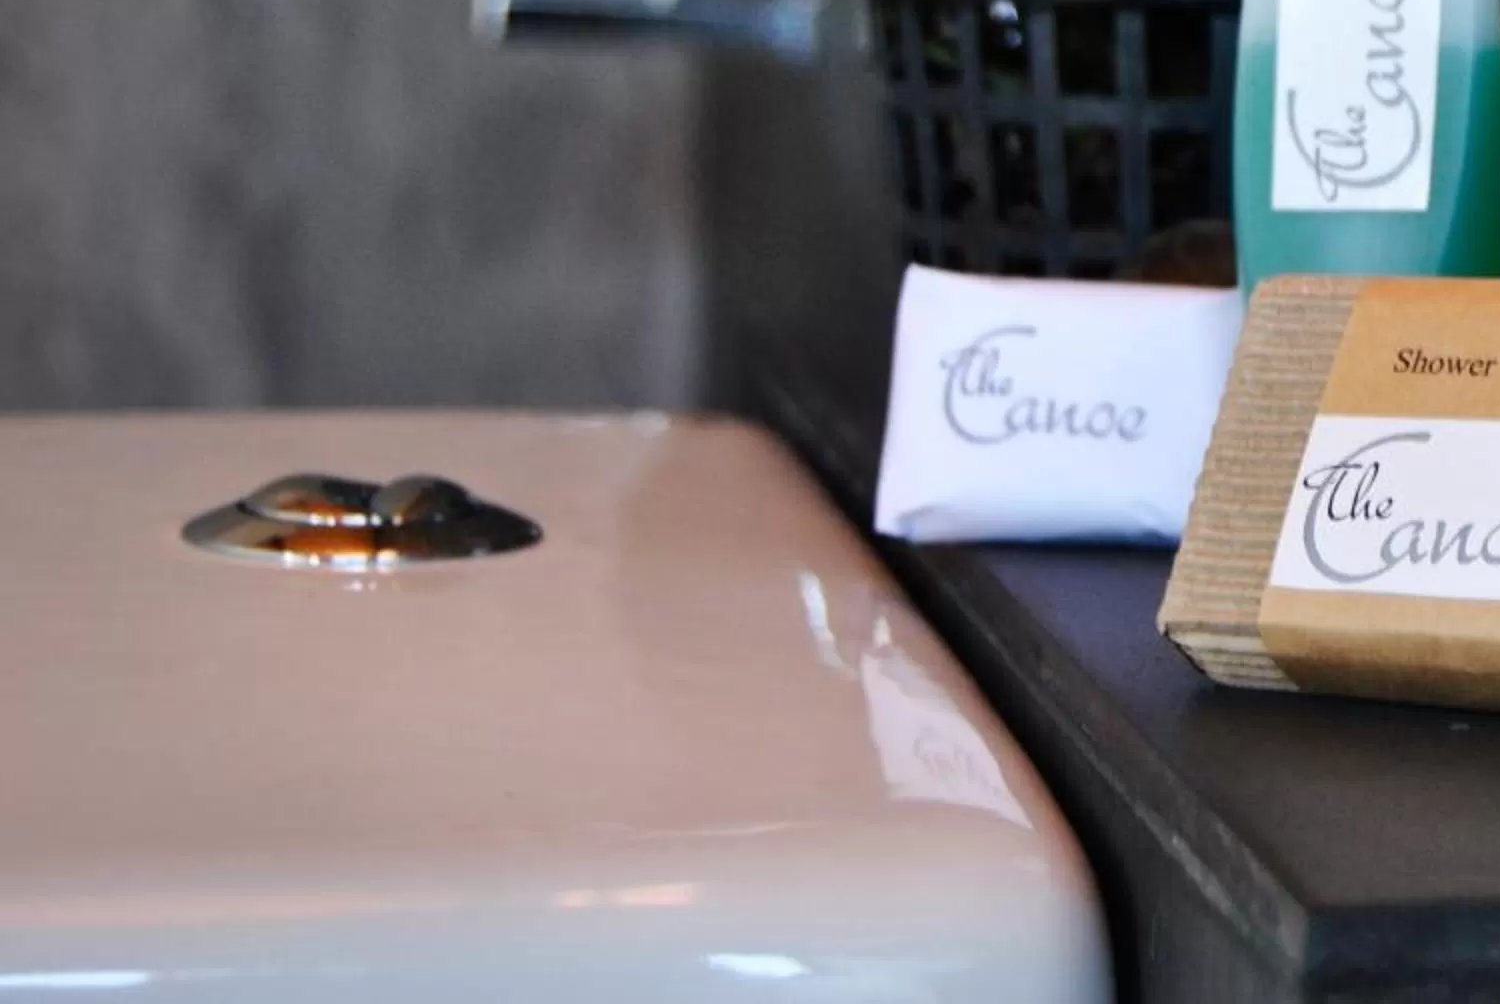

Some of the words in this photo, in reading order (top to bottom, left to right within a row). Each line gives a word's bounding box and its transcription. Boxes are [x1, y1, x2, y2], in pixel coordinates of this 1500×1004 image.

[1314, 104, 1367, 202] The
[940, 346, 1013, 396] The
[944, 325, 1148, 445] Canoe
[1394, 348, 1498, 377] Shower
[1303, 462, 1393, 521] The
